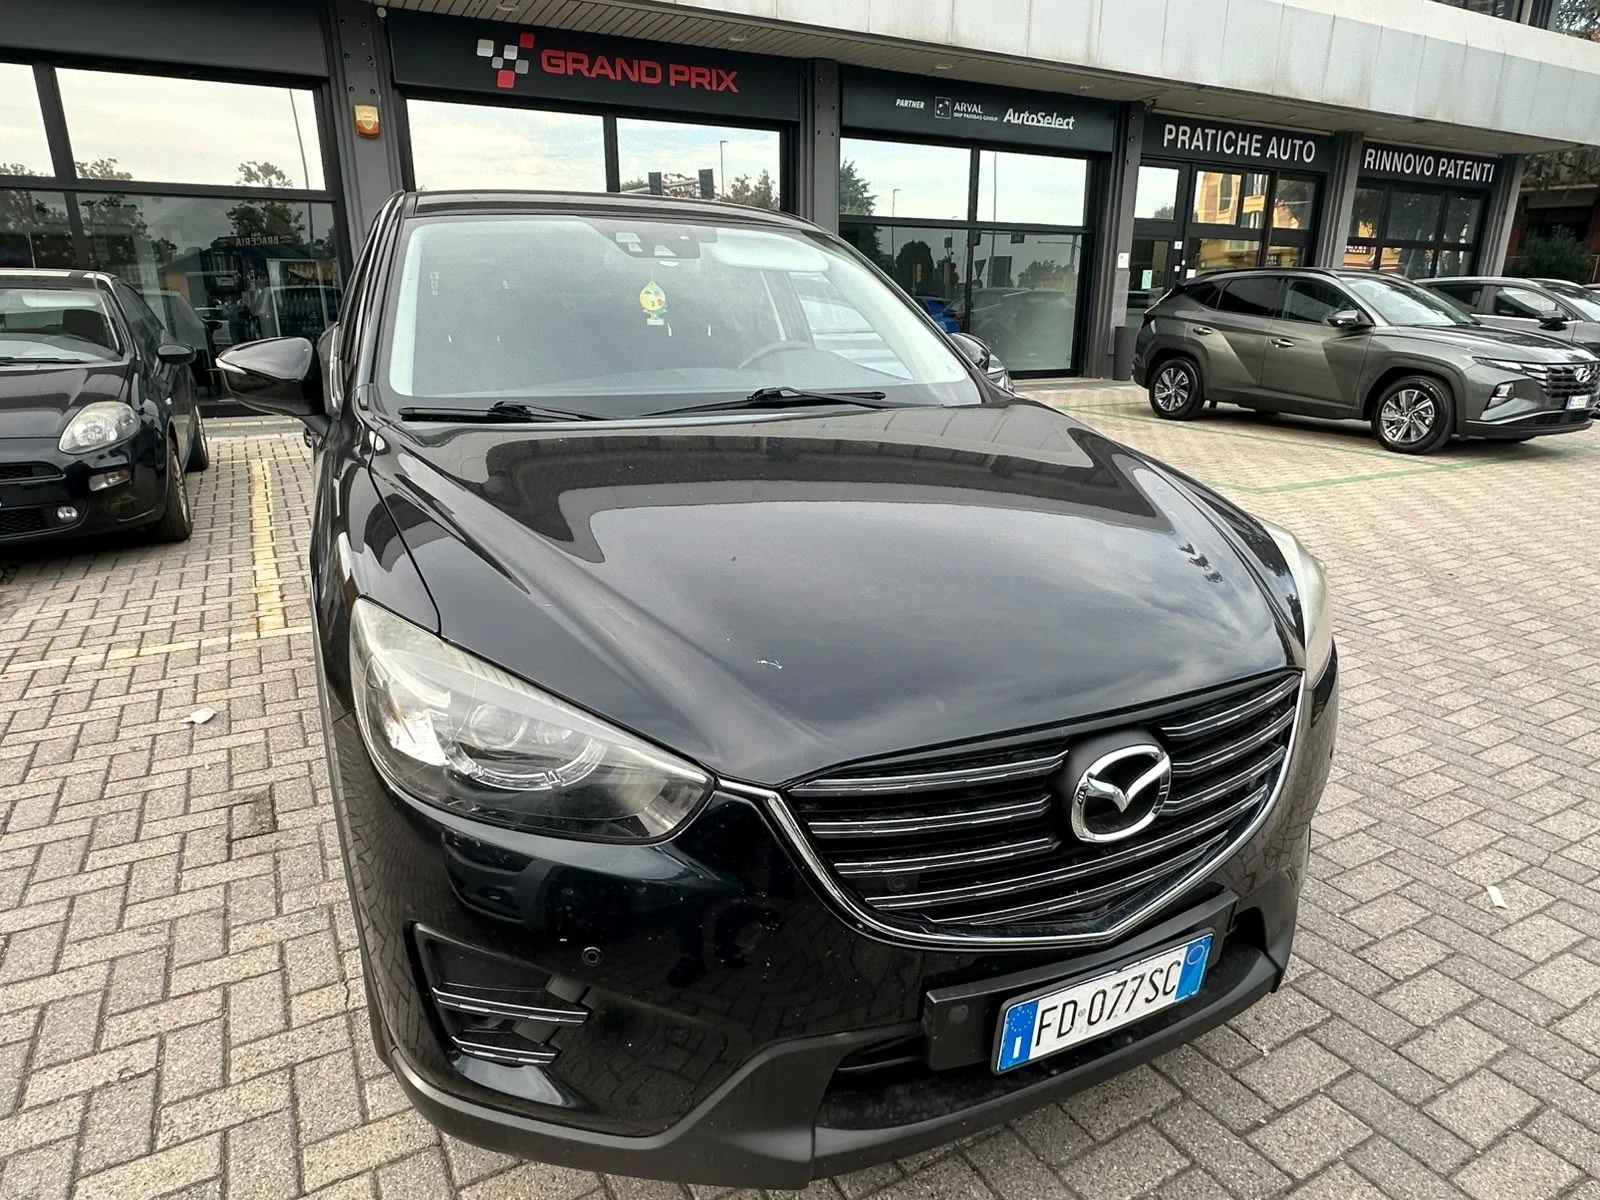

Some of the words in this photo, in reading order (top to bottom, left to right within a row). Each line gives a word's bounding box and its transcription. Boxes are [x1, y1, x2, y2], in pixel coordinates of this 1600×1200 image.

[540, 49, 662, 85] GRAND
[669, 63, 739, 94] PRIX
[895, 98, 925, 110] PARTNER
[953, 102, 983, 114] ARVAL
[1003, 108, 1075, 130] AutoSelect
[1163, 123, 1262, 158] PRATICHE
[1266, 136, 1316, 164] AUTO
[1364, 148, 1433, 177] RINNOVO
[1437, 157, 1495, 184] PATENTI
